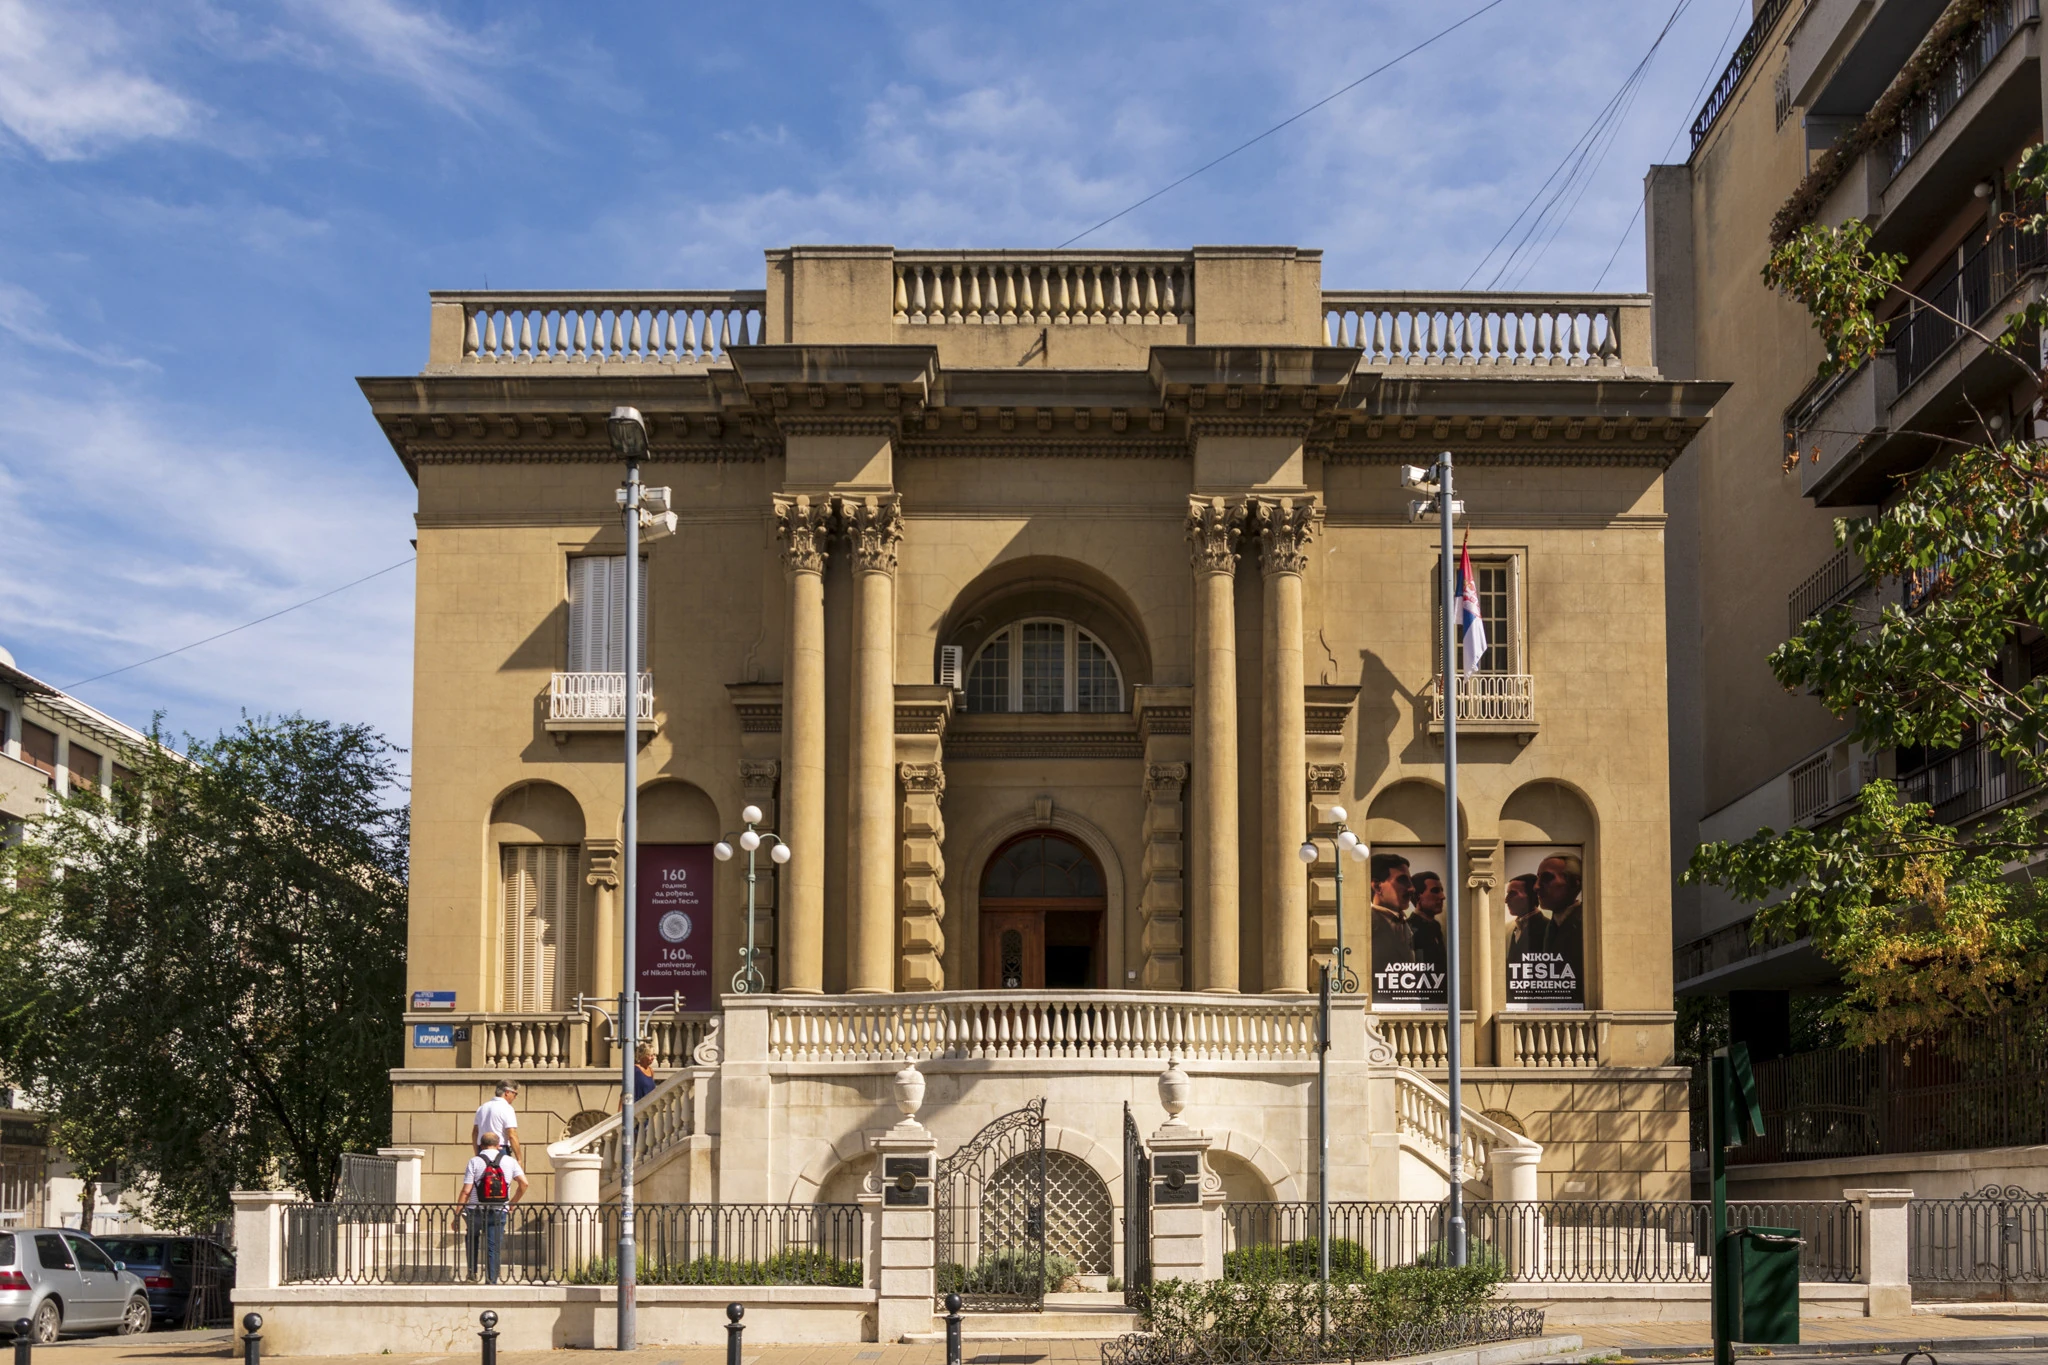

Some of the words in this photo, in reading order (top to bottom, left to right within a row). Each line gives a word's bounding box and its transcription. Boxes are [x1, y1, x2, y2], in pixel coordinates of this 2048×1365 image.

[662, 869, 686, 881] 160
[666, 890, 694, 898] рођења
[1522, 953, 1564, 962] NIKOLA
[1385, 962, 1435, 972] ДОЖИВИ
[1508, 963, 1576, 979] TESLA
[1374, 973, 1445, 989] ТЕСЛУ
[1509, 980, 1577, 990] EXPERIENCE
[419, 1035, 449, 1044] КРУНСКА
[458, 1030, 466, 1039] 51
